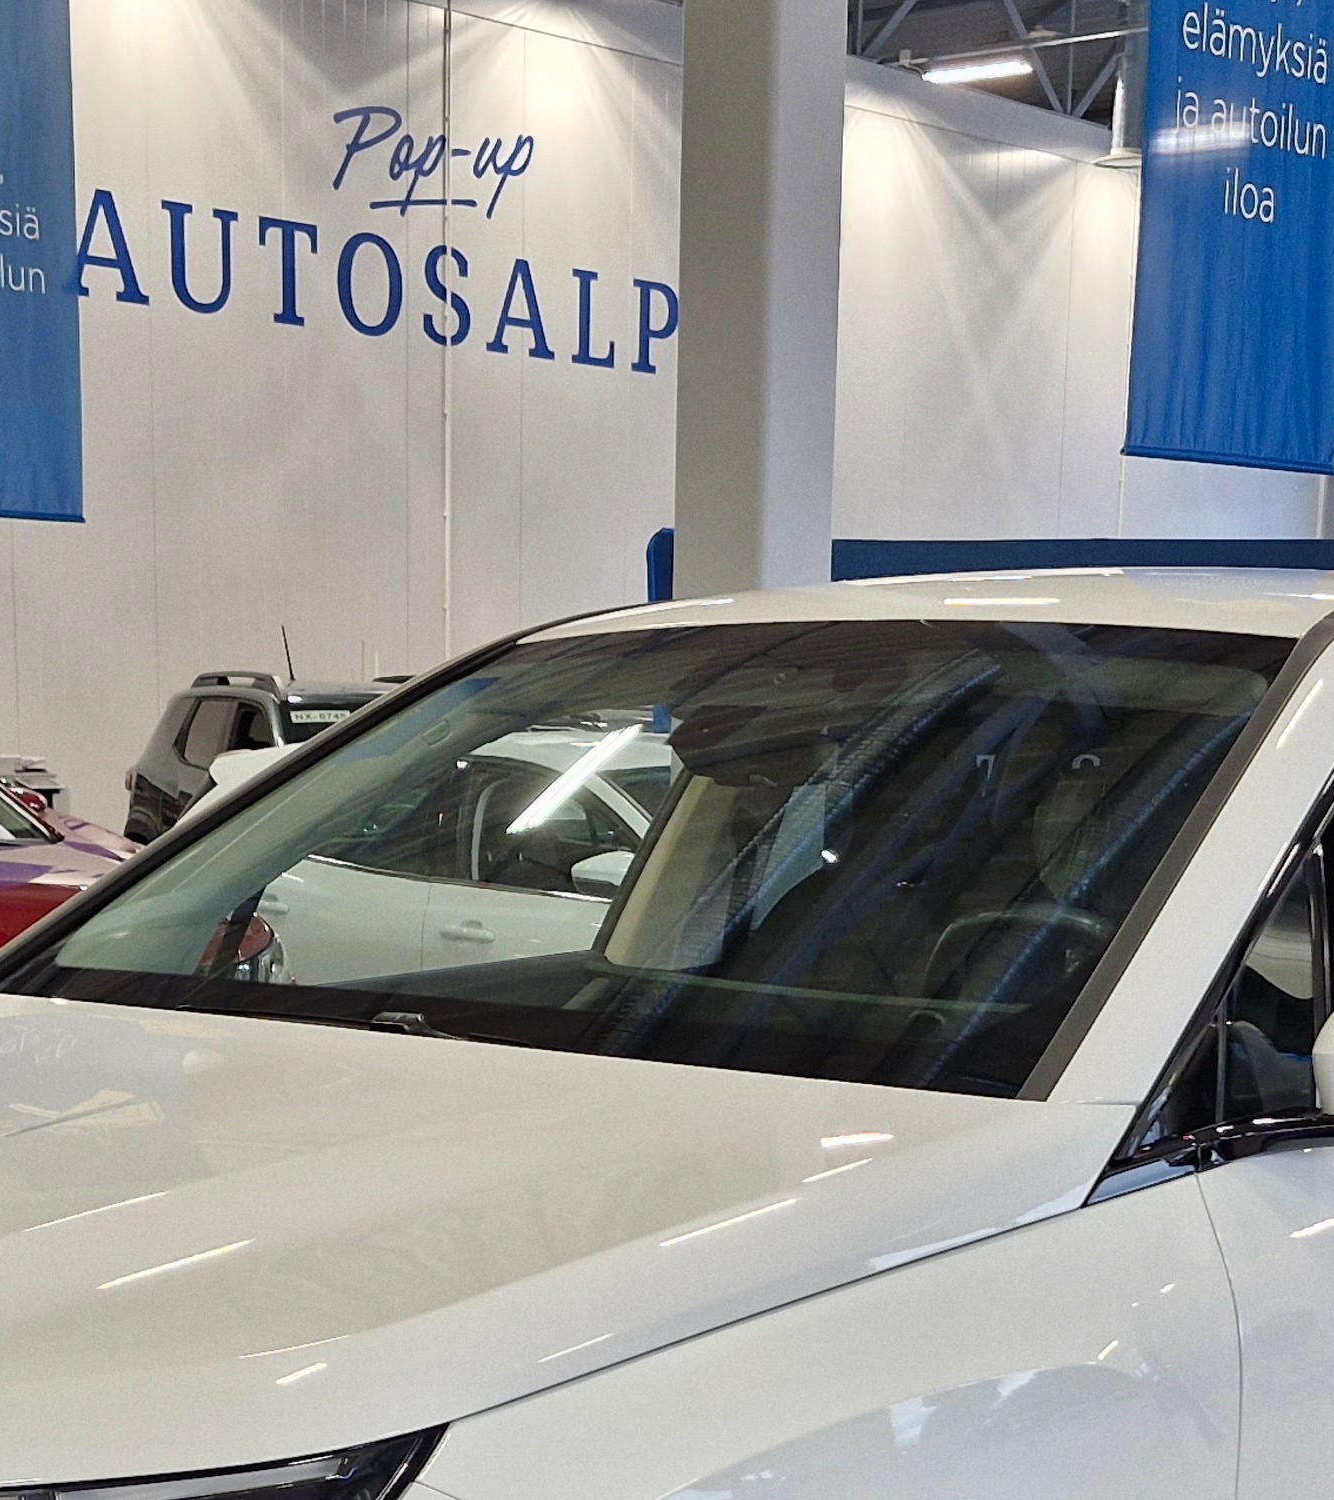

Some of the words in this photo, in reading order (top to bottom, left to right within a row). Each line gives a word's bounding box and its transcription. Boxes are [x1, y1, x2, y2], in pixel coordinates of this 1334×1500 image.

[1182, 2, 1329, 85] elämyksiä
[1172, 75, 1199, 135] ja
[1209, 94, 1328, 160] autoilun
[333, 106, 535, 219] Pop-up
[1223, 166, 1276, 224] iloa
[76, 188, 680, 375] AUTOSALP
